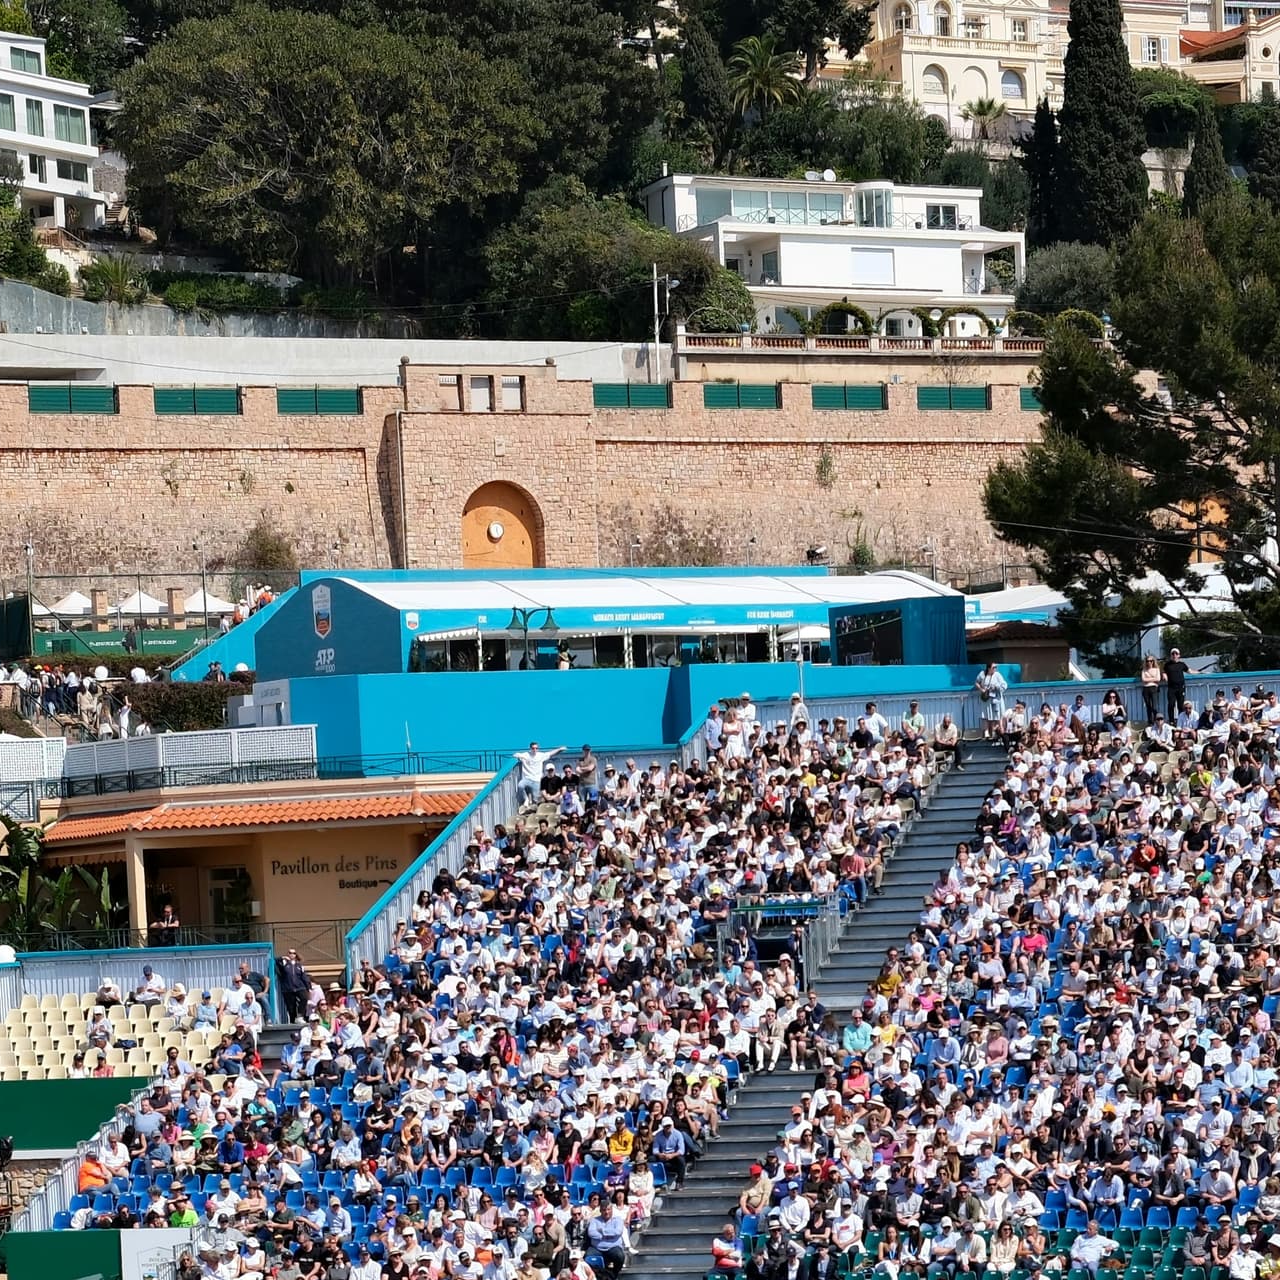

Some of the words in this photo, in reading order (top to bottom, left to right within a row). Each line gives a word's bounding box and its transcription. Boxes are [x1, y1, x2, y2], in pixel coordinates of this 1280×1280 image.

[271, 856, 330, 876] Pavillon
[335, 856, 360, 873] des
[365, 855, 398, 872] Pins
[339, 879, 378, 890] Boutique
